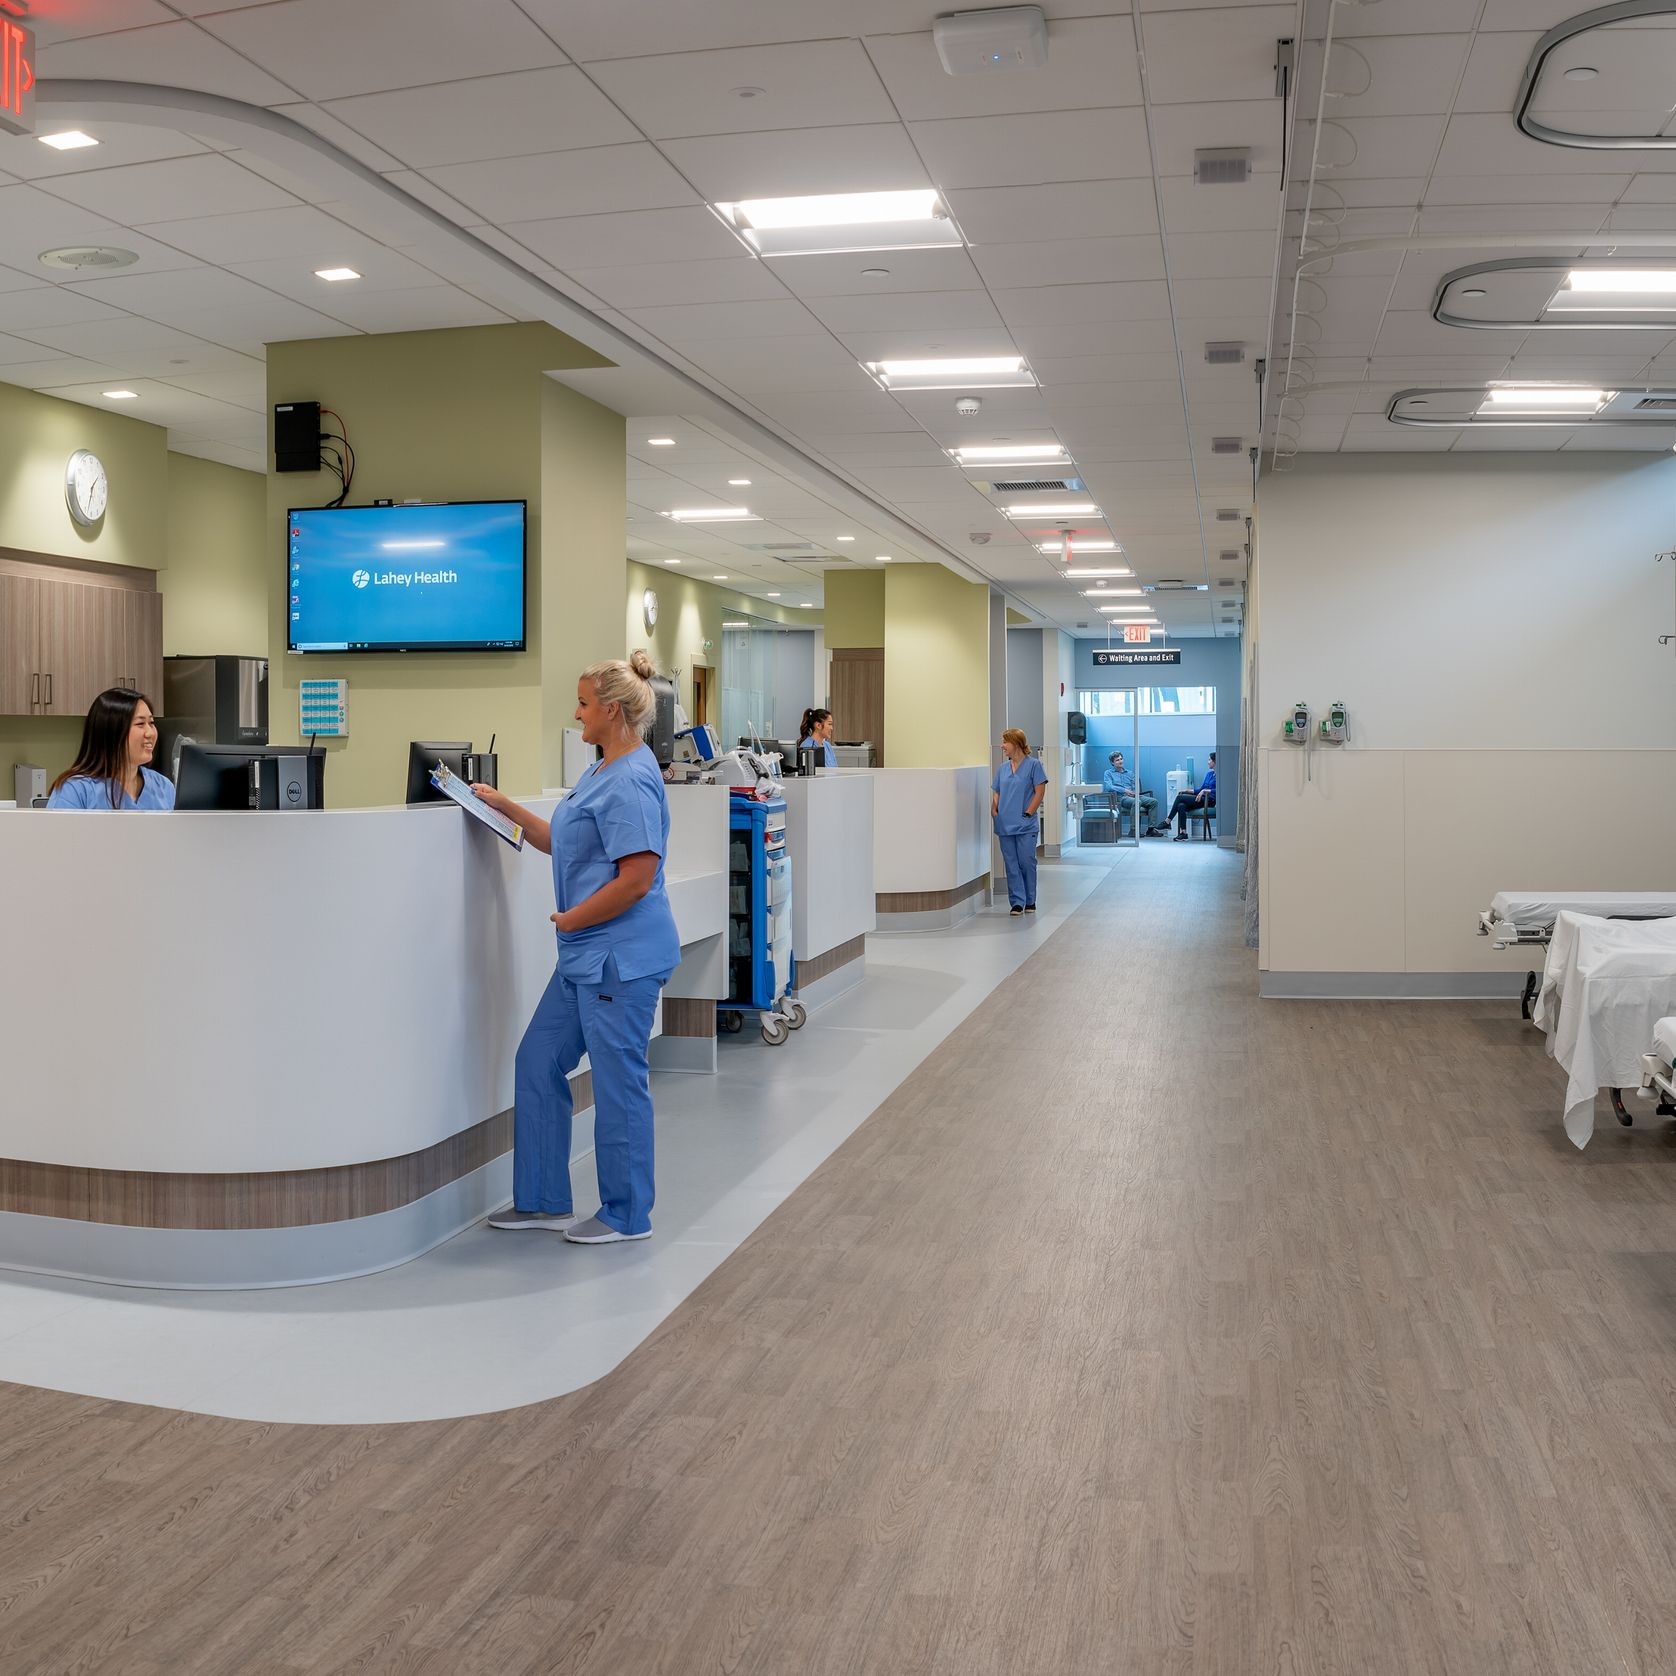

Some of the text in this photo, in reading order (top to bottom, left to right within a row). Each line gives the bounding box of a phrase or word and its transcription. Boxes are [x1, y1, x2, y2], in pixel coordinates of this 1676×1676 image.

[0, 16, 25, 115] IT
[374, 570, 458, 587] Lahey Health
[1129, 627, 1147, 641] EXIT
[1109, 653, 1174, 664] Waiting Area and Exit
